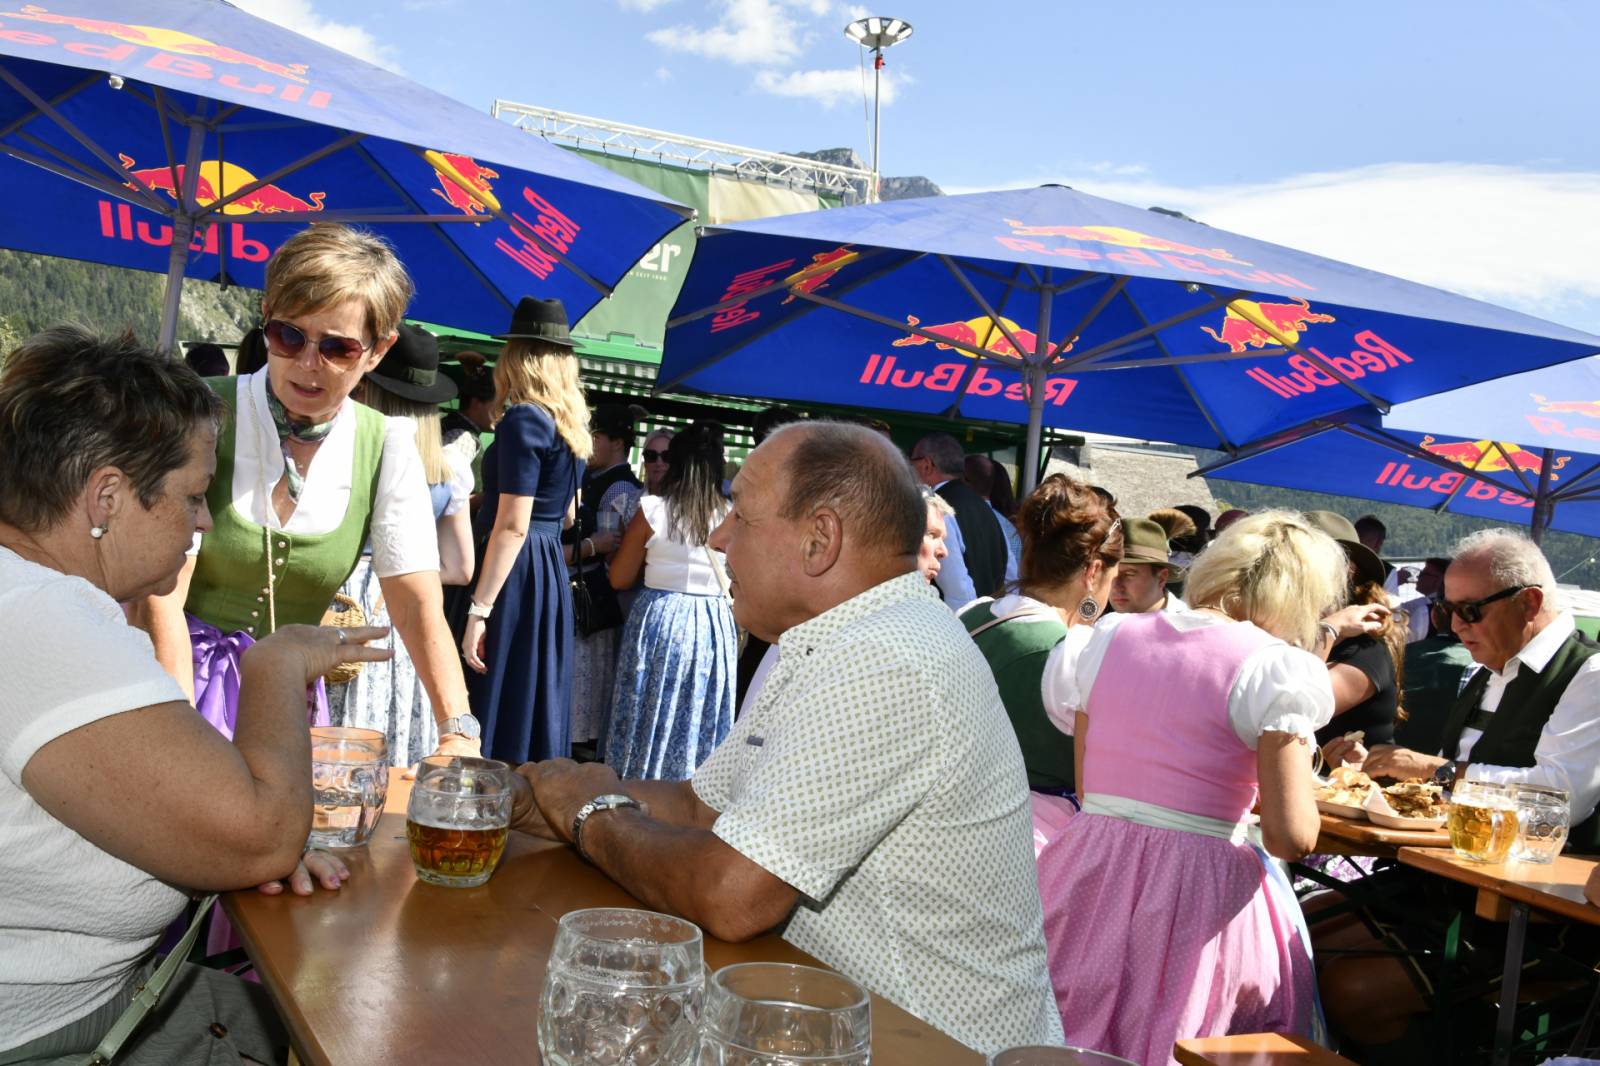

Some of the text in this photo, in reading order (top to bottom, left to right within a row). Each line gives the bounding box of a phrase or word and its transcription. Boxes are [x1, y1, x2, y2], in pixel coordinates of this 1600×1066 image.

[0, 22, 332, 109] ed Bull
[994, 236, 1317, 291] Red Bull
